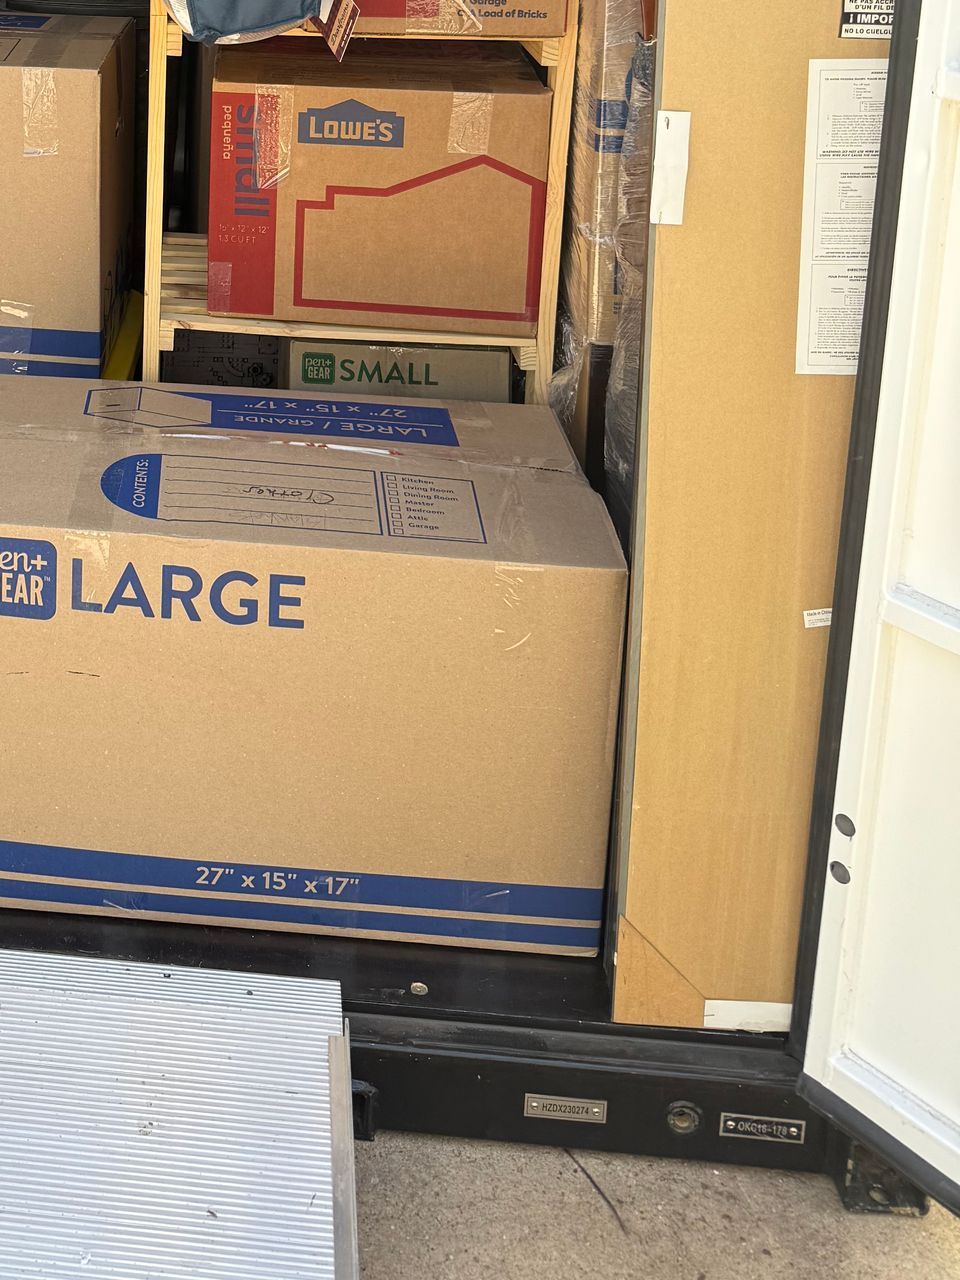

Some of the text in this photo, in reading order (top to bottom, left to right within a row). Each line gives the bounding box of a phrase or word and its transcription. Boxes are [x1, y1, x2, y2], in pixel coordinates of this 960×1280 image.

[222, 106, 233, 160] pequeña
[310, 116, 392, 141] LOWE'S
[308, 367, 330, 379] GEAR
[340, 359, 438, 385] SMALL
[246, 401, 276, 410] 17"
[306, 404, 339, 414] 15"
[370, 408, 407, 417] 27"
[235, 414, 314, 427] GRANDE
[342, 424, 427, 437] LARGE
[133, 458, 149, 508] CONTENTS:
[72, 557, 305, 628] LARGE
[196, 867, 359, 895] 27" x 15" x 17"
